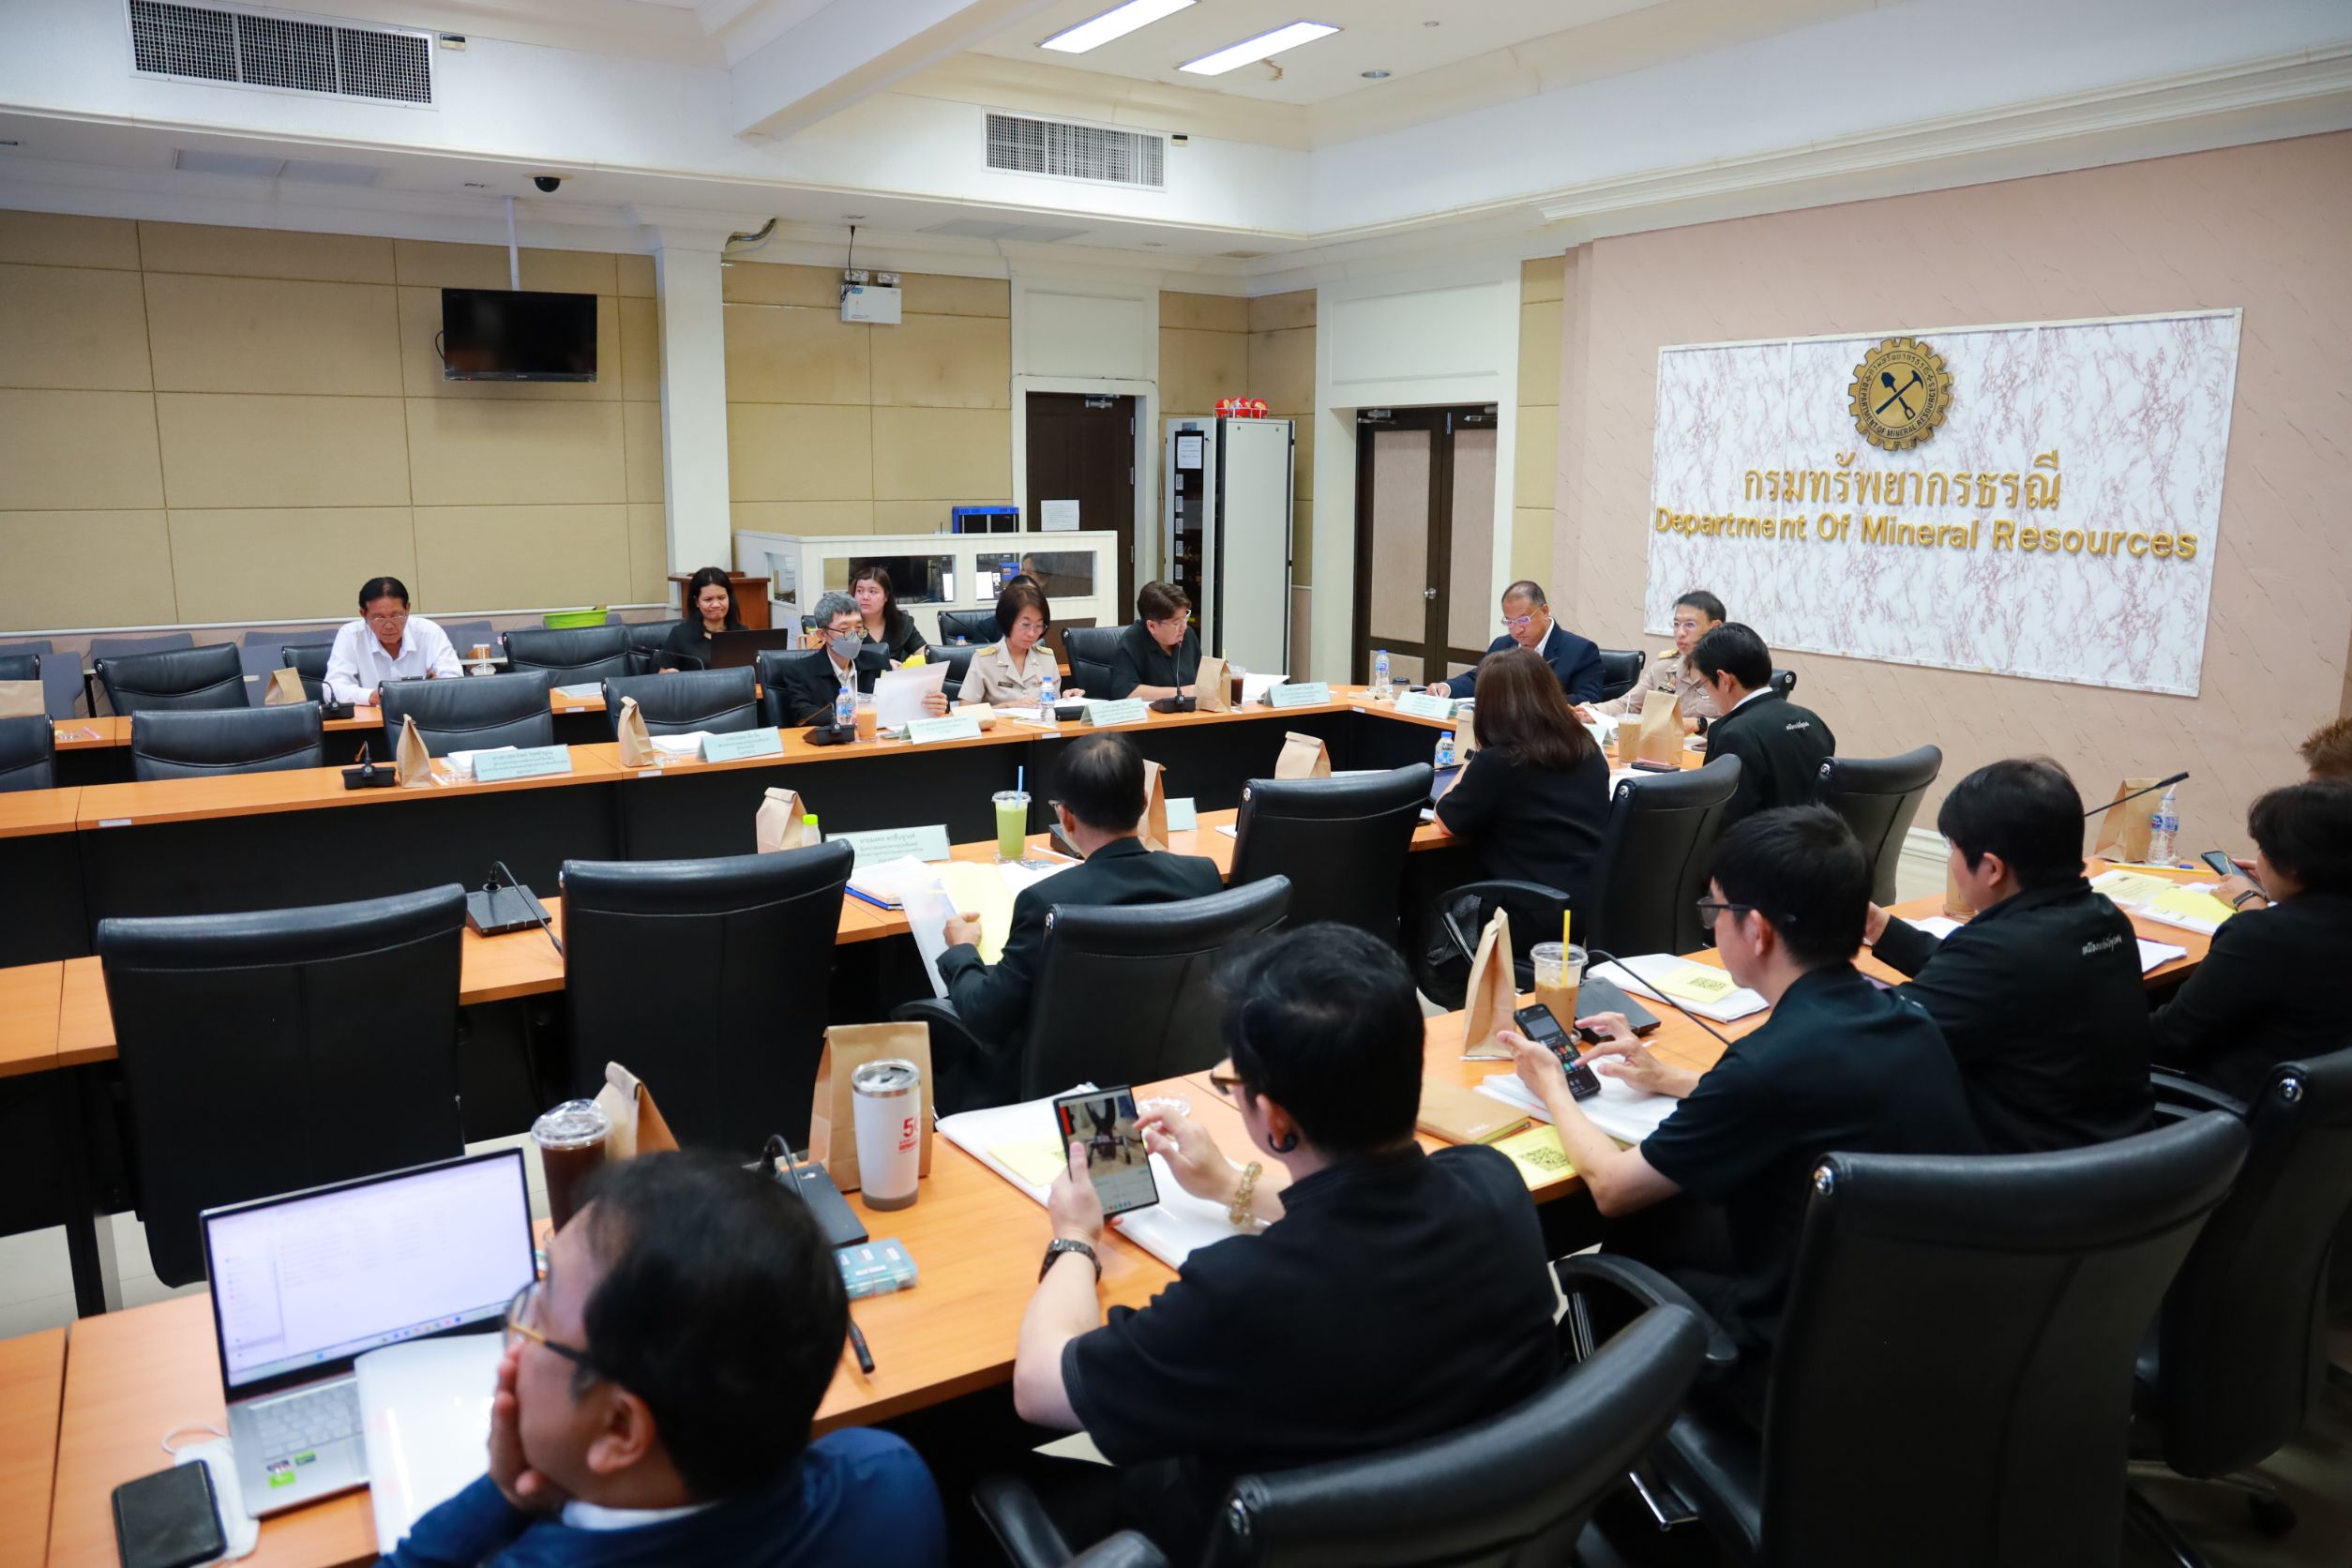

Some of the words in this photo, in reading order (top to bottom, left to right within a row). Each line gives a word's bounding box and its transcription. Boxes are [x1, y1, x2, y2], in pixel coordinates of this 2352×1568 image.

[1861, 382, 1877, 428] DEPARTMENT
[1887, 425, 1916, 437] MINERAL
[1917, 383, 1936, 427] RESOURCES
[1744, 450, 2061, 510] กรมทรัพยากรธรณี
[1655, 506, 1807, 538] Department
[1817, 512, 1852, 541] Of
[1861, 515, 1979, 550] Mineral
[1992, 519, 2197, 559] Resources
